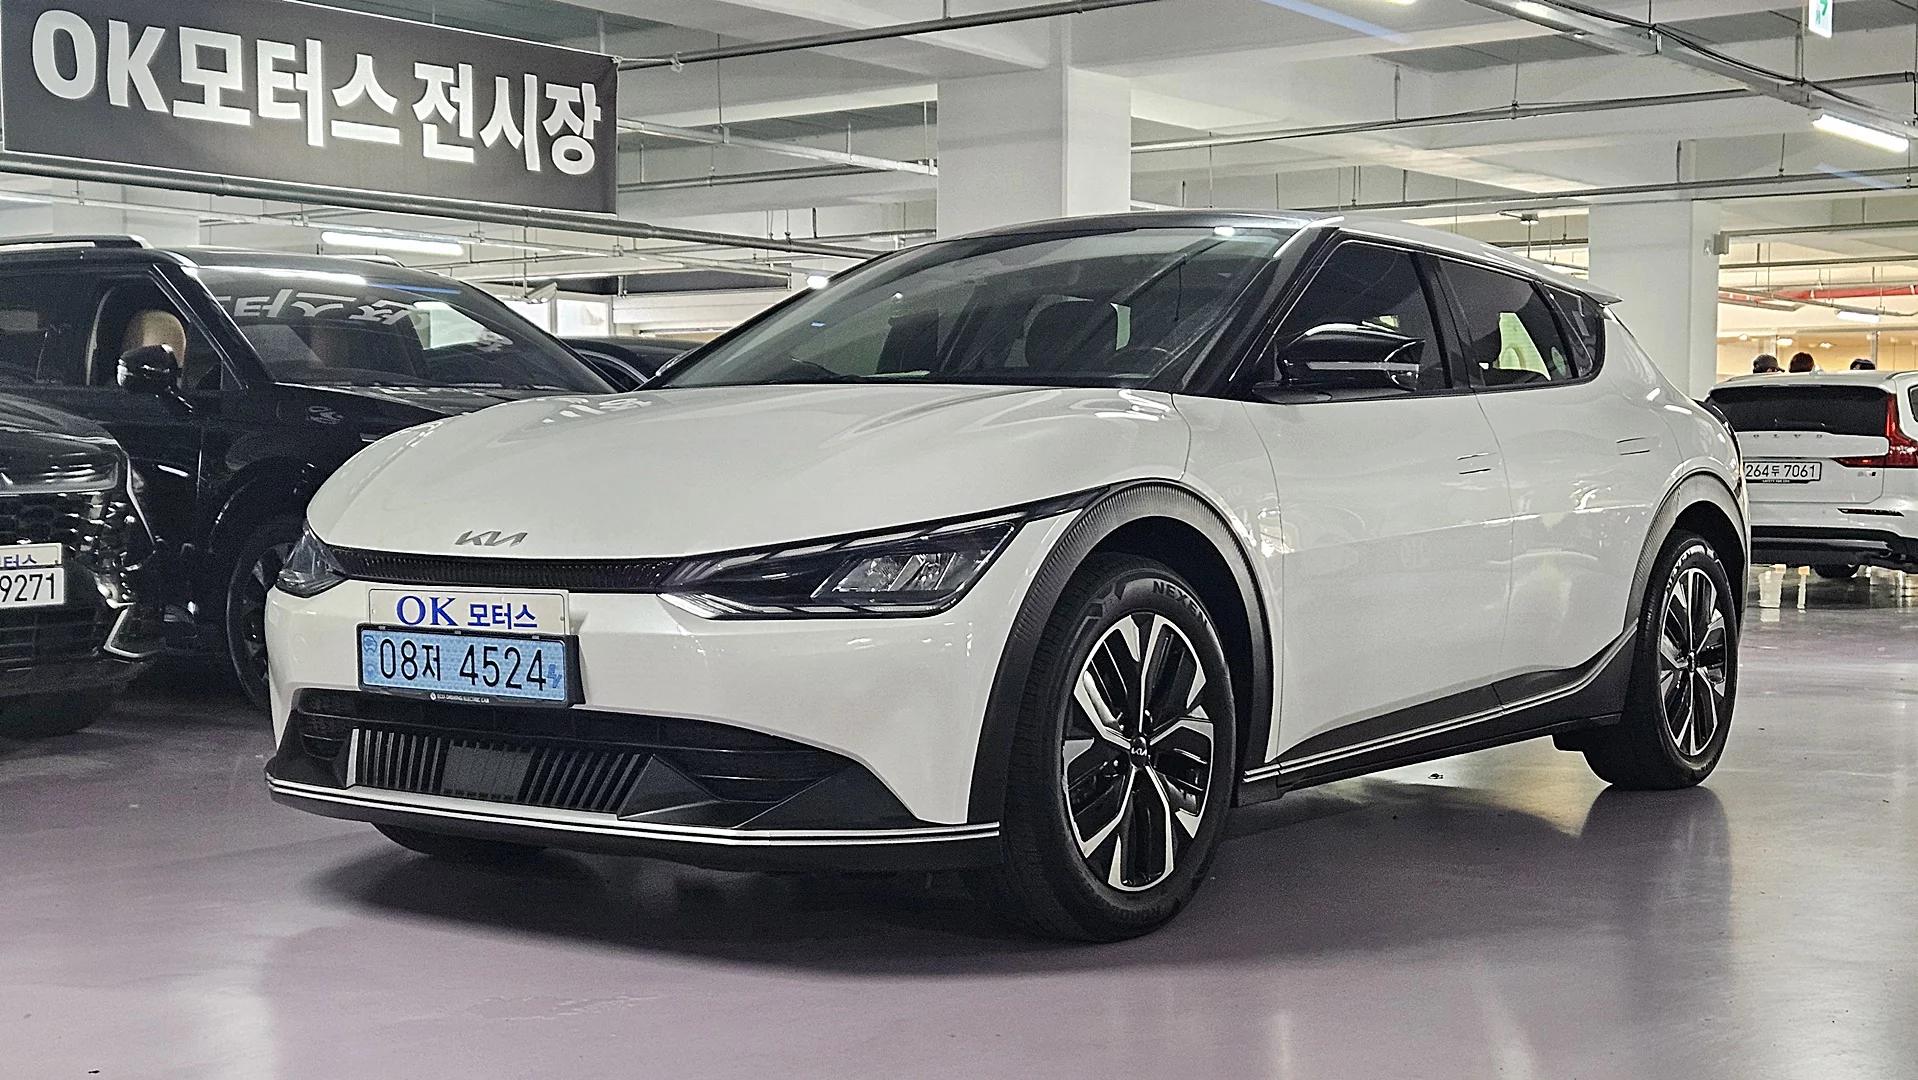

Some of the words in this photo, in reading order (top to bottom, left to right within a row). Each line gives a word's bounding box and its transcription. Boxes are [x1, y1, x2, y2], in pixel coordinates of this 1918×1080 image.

[1783, 464, 1815, 478] 7061
[0, 572, 55, 603] 9271
[1152, 580, 1208, 625] NEXEN
[396, 595, 459, 627] OK
[467, 602, 538, 630] 모터스
[380, 638, 441, 682] 08저
[459, 644, 547, 692] 4524
